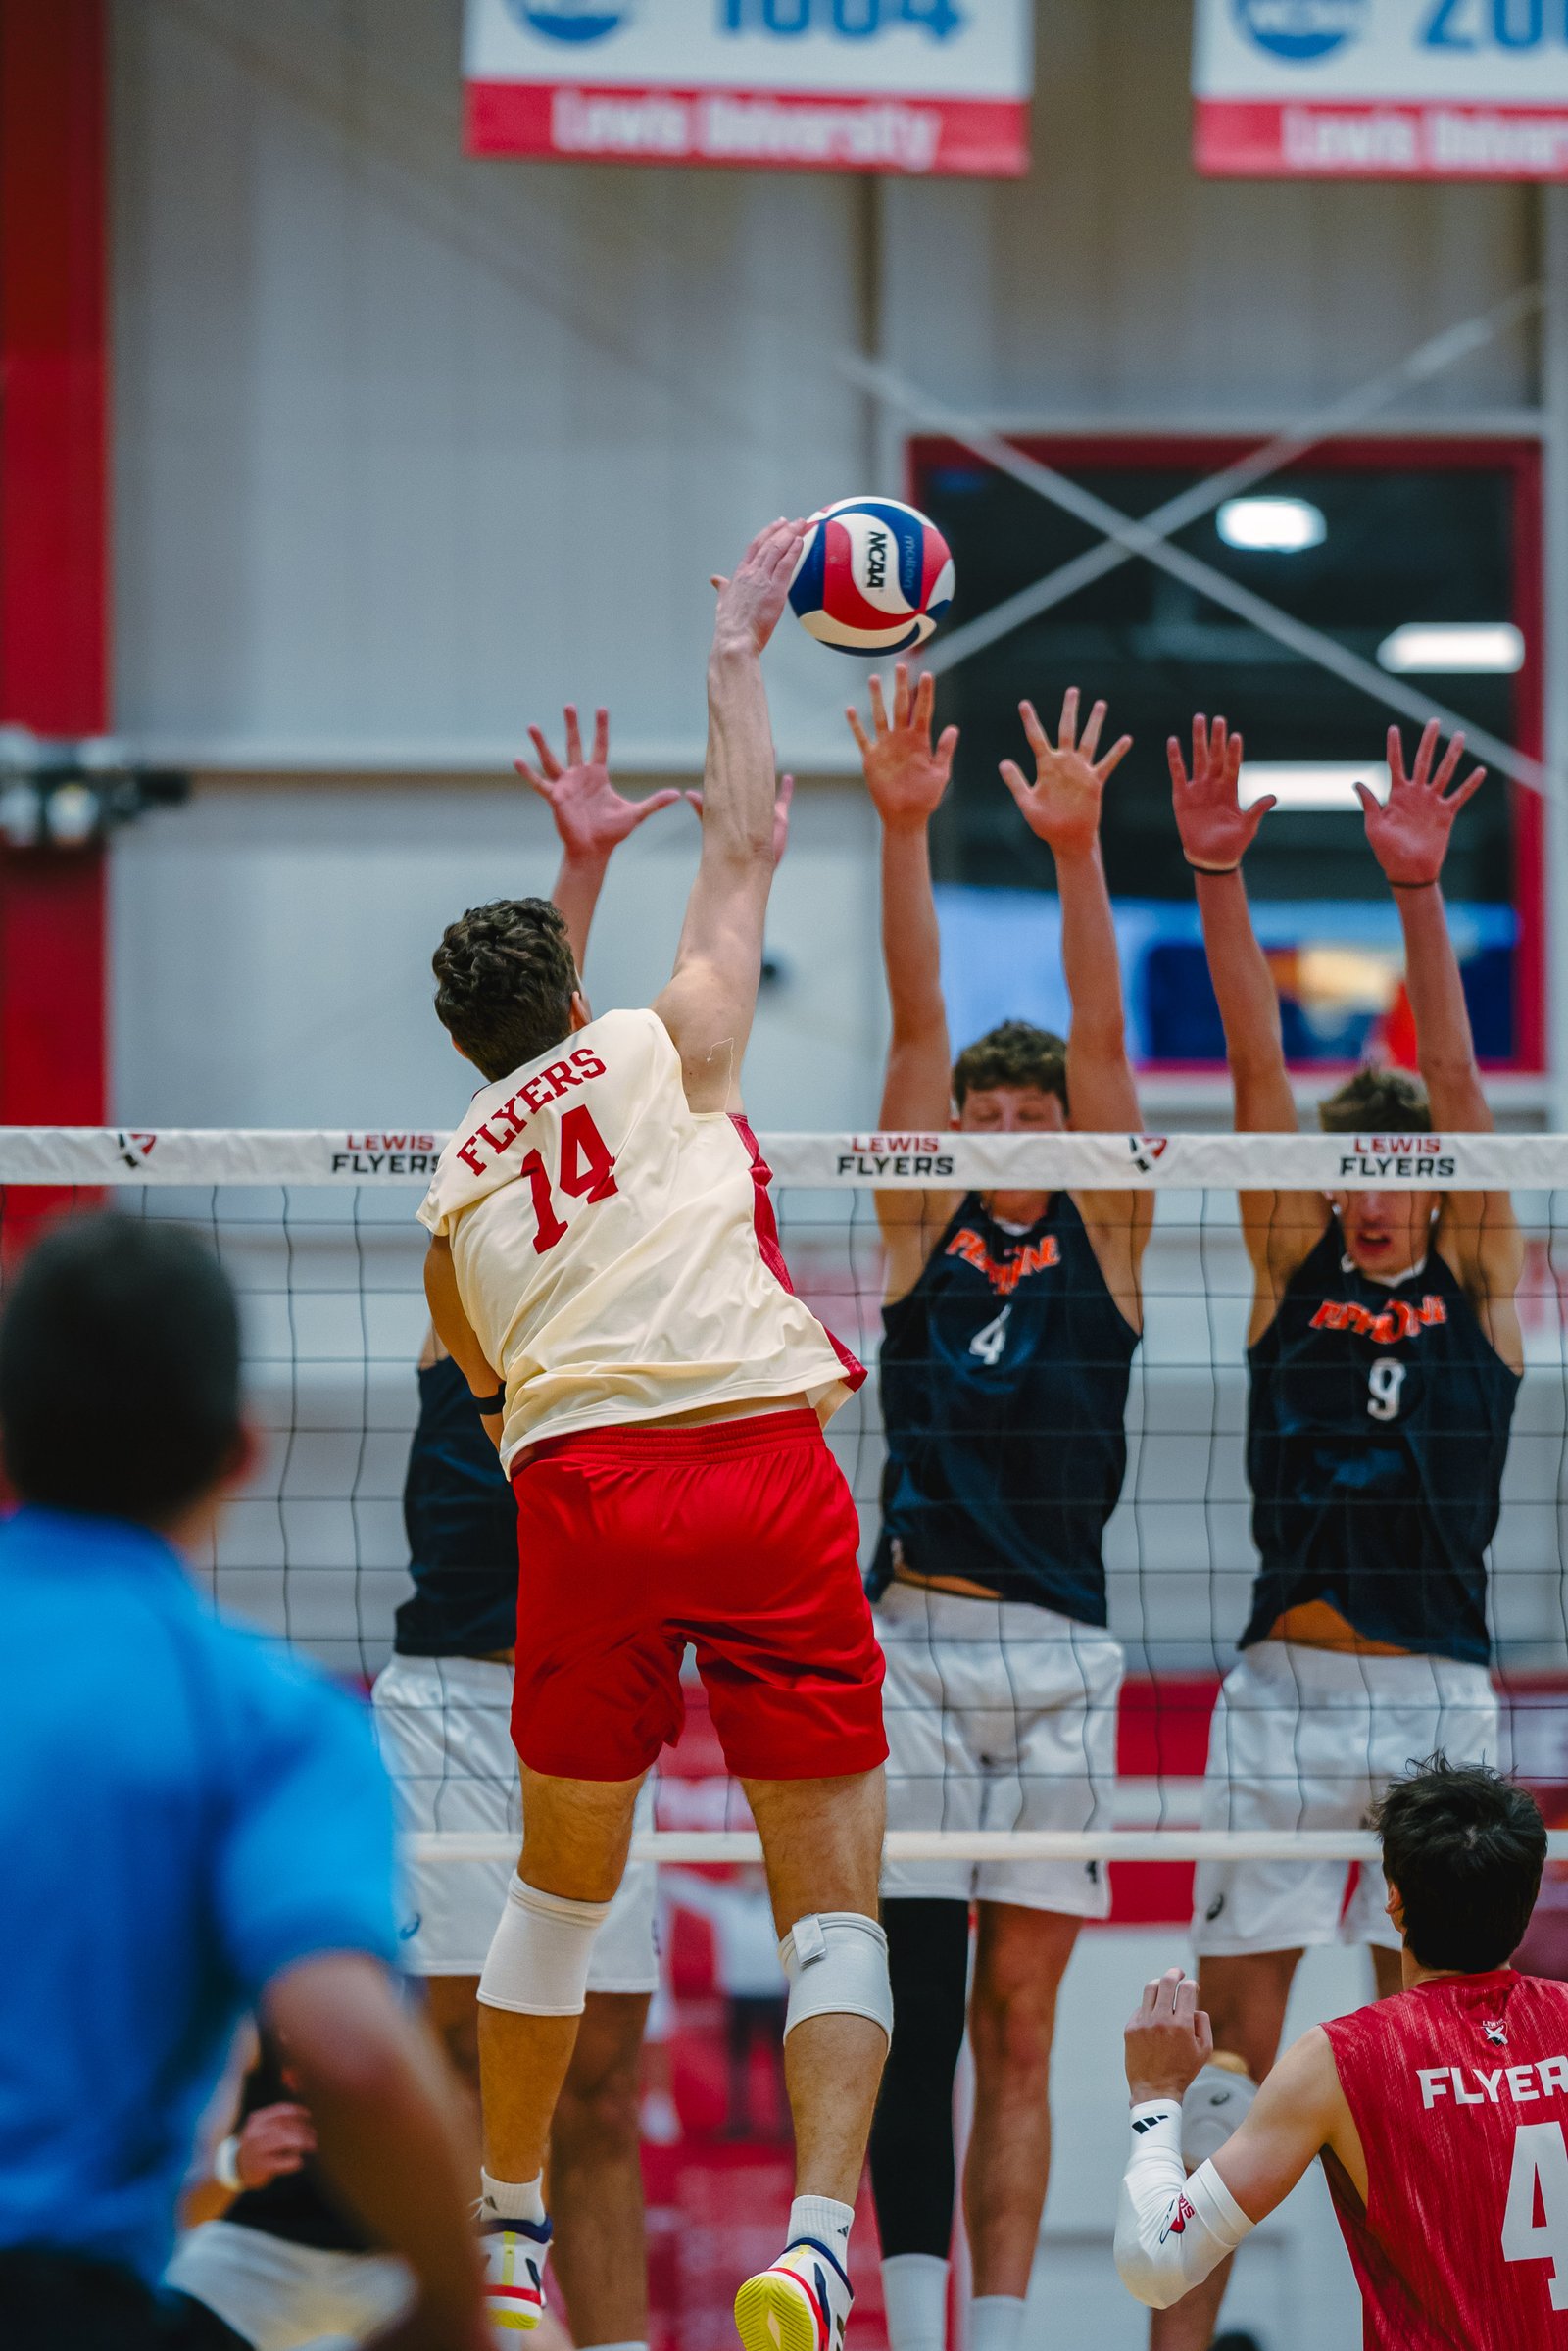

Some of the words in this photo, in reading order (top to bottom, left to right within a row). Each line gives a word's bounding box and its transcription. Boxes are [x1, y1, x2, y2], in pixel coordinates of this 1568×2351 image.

[456, 1048, 607, 1176] FLYERS
[347, 1135, 434, 1151] LEWIS
[838, 1156, 954, 1175] FLYERS
[852, 1137, 939, 1152] LEWIS
[1340, 1157, 1455, 1176] FLYERS
[1353, 1137, 1442, 1153] LEWIS
[520, 1103, 619, 1255] 14
[969, 1303, 1012, 1365] 4
[1367, 1357, 1406, 1420] 9
[1416, 2055, 1568, 2109] FLYER
[1501, 2121, 1568, 2311] 4
